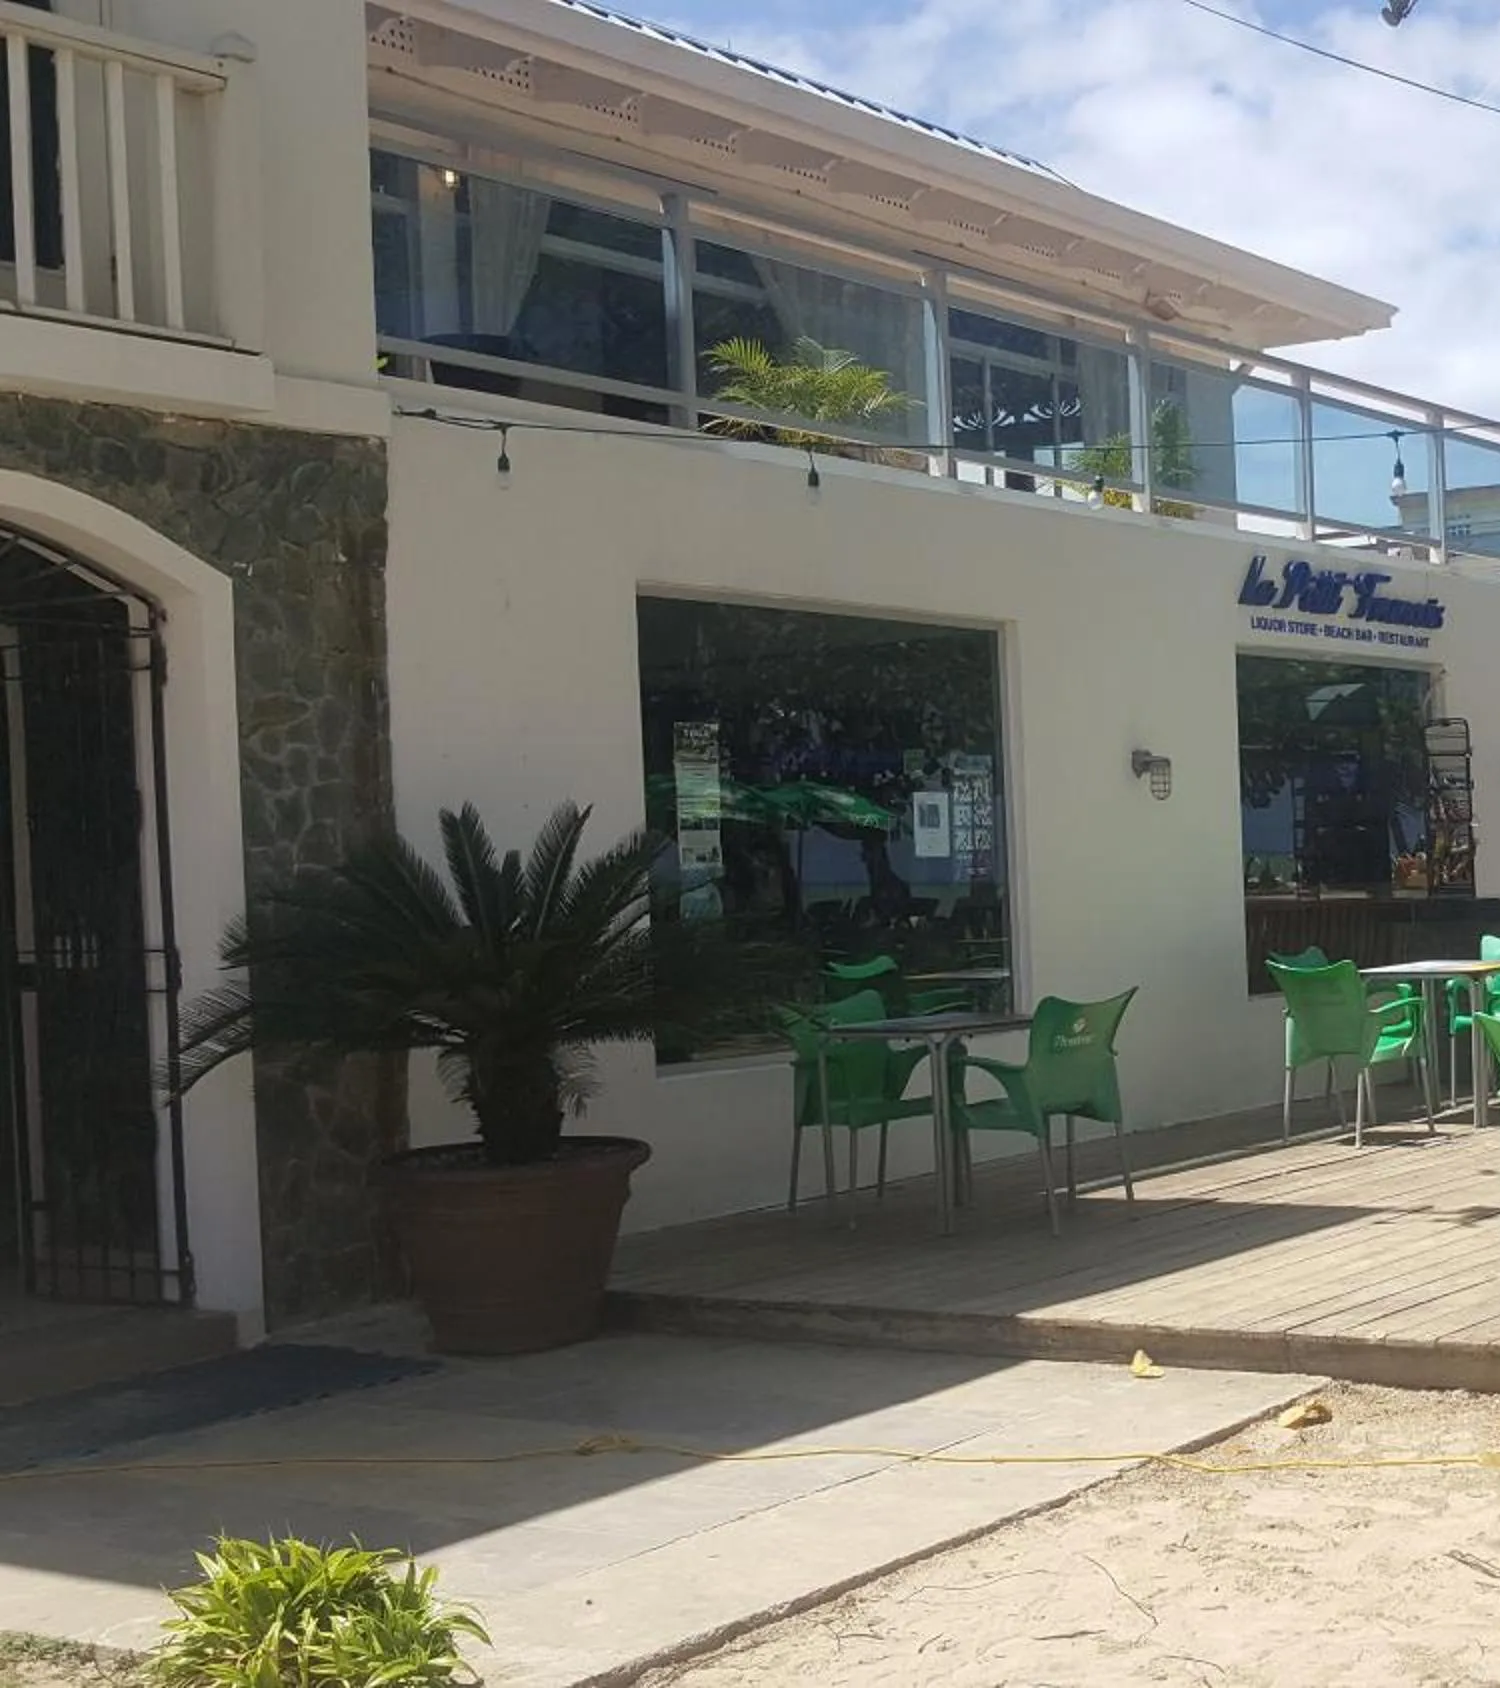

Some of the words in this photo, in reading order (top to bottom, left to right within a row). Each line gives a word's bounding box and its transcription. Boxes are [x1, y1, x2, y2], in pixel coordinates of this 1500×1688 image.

[1251, 615, 1287, 633] LIQUOR
[1287, 620, 1319, 637] STORE
[1324, 624, 1352, 640] BEACH
[1355, 628, 1373, 642] BAR
[1378, 631, 1431, 648] RESTAURANT
